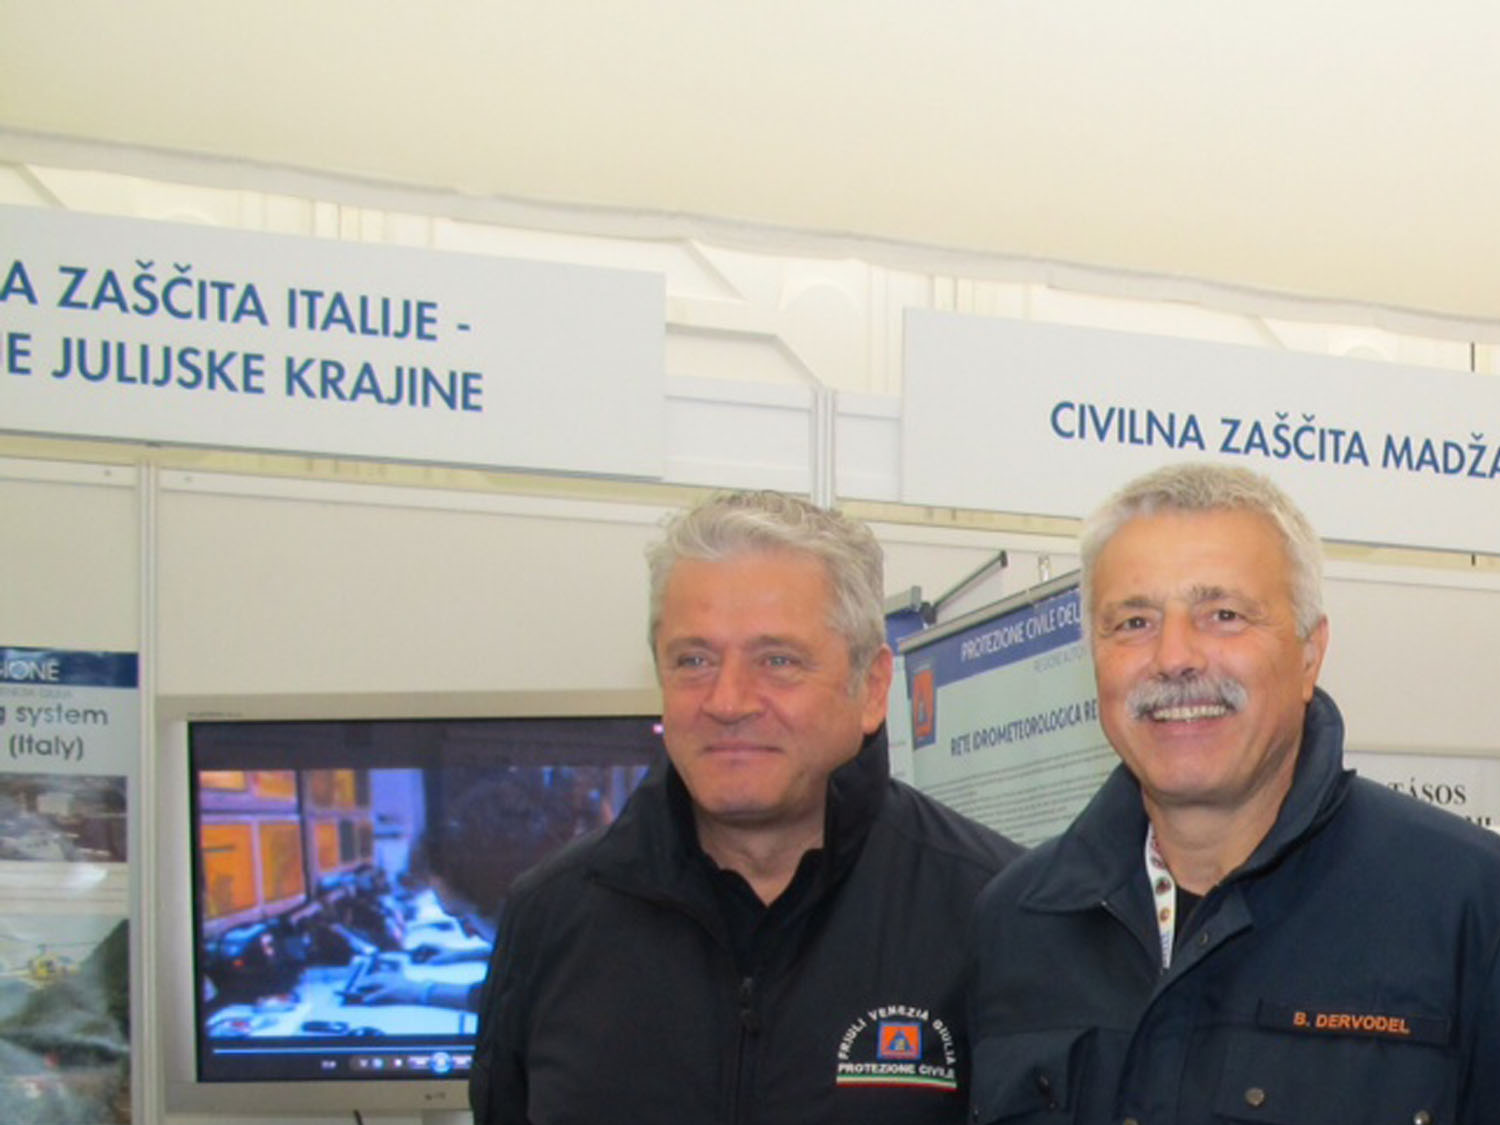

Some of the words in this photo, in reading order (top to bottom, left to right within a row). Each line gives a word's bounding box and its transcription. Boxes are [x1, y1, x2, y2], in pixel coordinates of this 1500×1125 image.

[57, 259, 268, 327] ZAŠČITA
[287, 287, 438, 342] ITALIJE
[51, 337, 265, 394] JULIJSKE
[285, 355, 483, 413] KRAJINE
[1050, 401, 1206, 451] CIVILNA
[1219, 411, 1369, 467] ZAŠČITA
[16, 703, 109, 727] system
[9, 733, 84, 761] (Italy)
[838, 1018, 867, 1060] FRIULI
[867, 1005, 930, 1021] VENEZIA
[932, 1019, 957, 1065] GIULIA
[1293, 1012, 1311, 1028] B.
[1315, 1014, 1411, 1034] DERVODEL
[838, 1063, 916, 1075] PROTEZIONE
[918, 1064, 956, 1080] CIVILE
